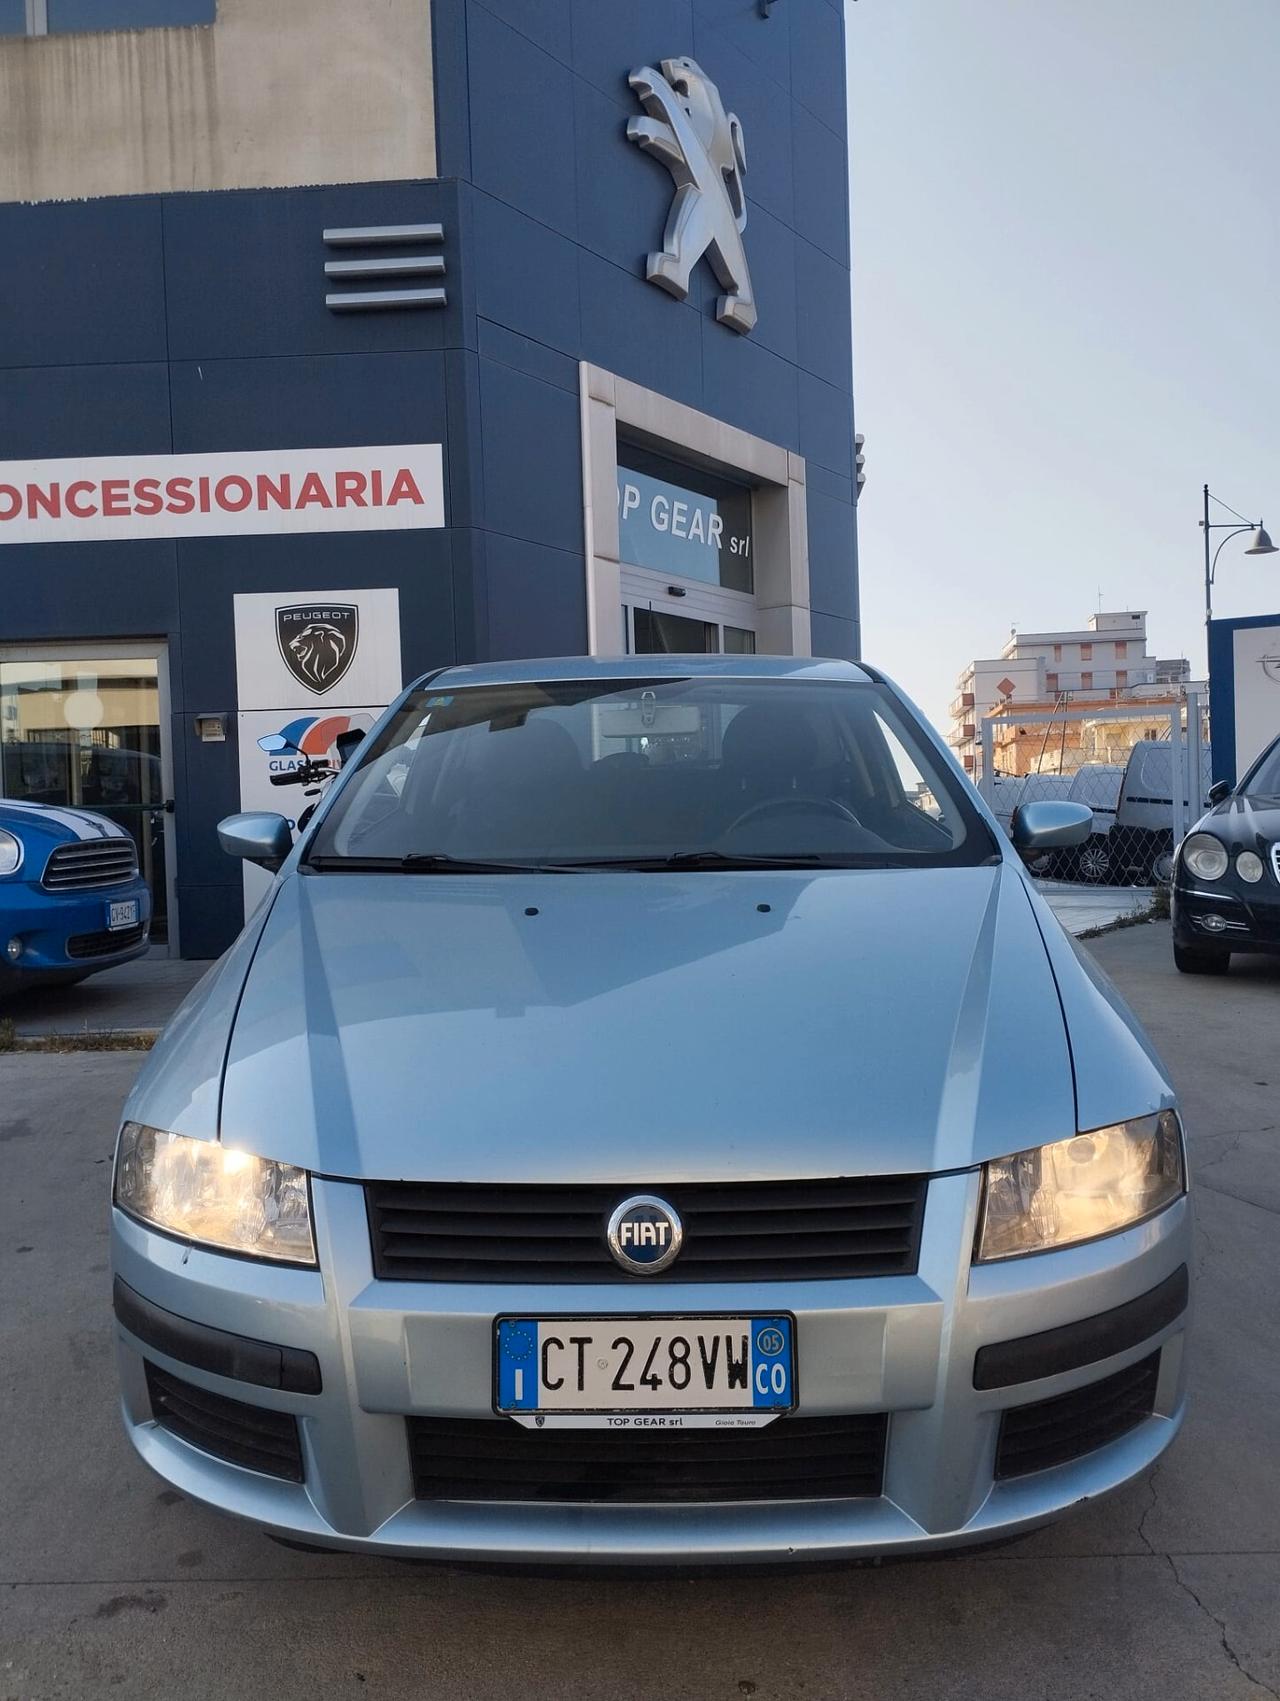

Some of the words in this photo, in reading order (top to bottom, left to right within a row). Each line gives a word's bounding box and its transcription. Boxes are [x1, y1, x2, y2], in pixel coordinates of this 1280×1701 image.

[0, 468, 425, 521] ONCESSIONARIA
[651, 495, 724, 549] GEAR
[730, 536, 750, 558] srl
[283, 611, 351, 622] PEUGEOT
[620, 1222, 669, 1246] FIAT
[763, 1334, 780, 1351] 05
[541, 1336, 593, 1392] CT
[611, 1335, 749, 1391] 248VW
[755, 1363, 786, 1395] CO
[607, 1417, 630, 1427] TOP
[634, 1417, 666, 1427] GEAR
[669, 1416, 684, 1427] srl
